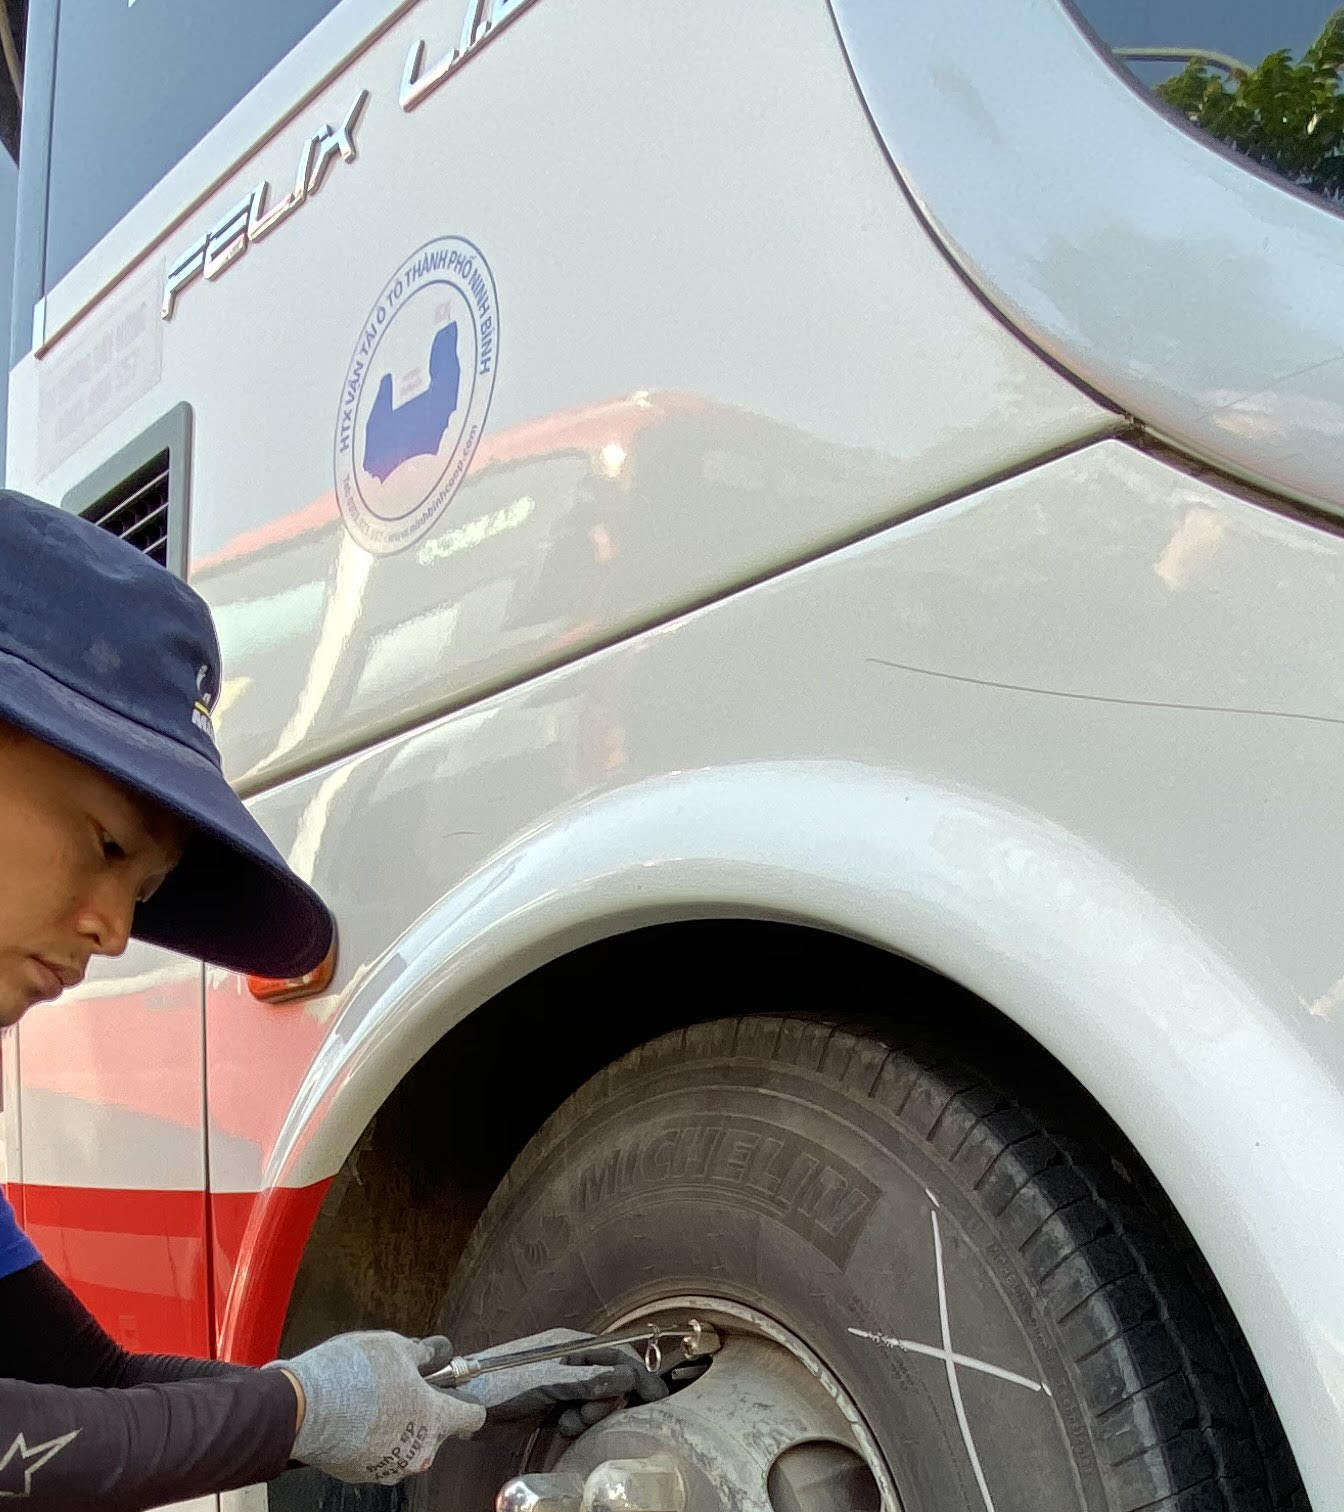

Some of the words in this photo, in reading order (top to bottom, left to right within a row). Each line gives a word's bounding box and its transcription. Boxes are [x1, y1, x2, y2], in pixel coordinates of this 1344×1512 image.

[160, 88, 371, 322] FELIX
[447, 250, 478, 280] PHỐ
[468, 268, 491, 319] NINH
[479, 316, 496, 376] BÌNH
[339, 409, 354, 453] HTX
[576, 1126, 871, 1237] MICHELIN
